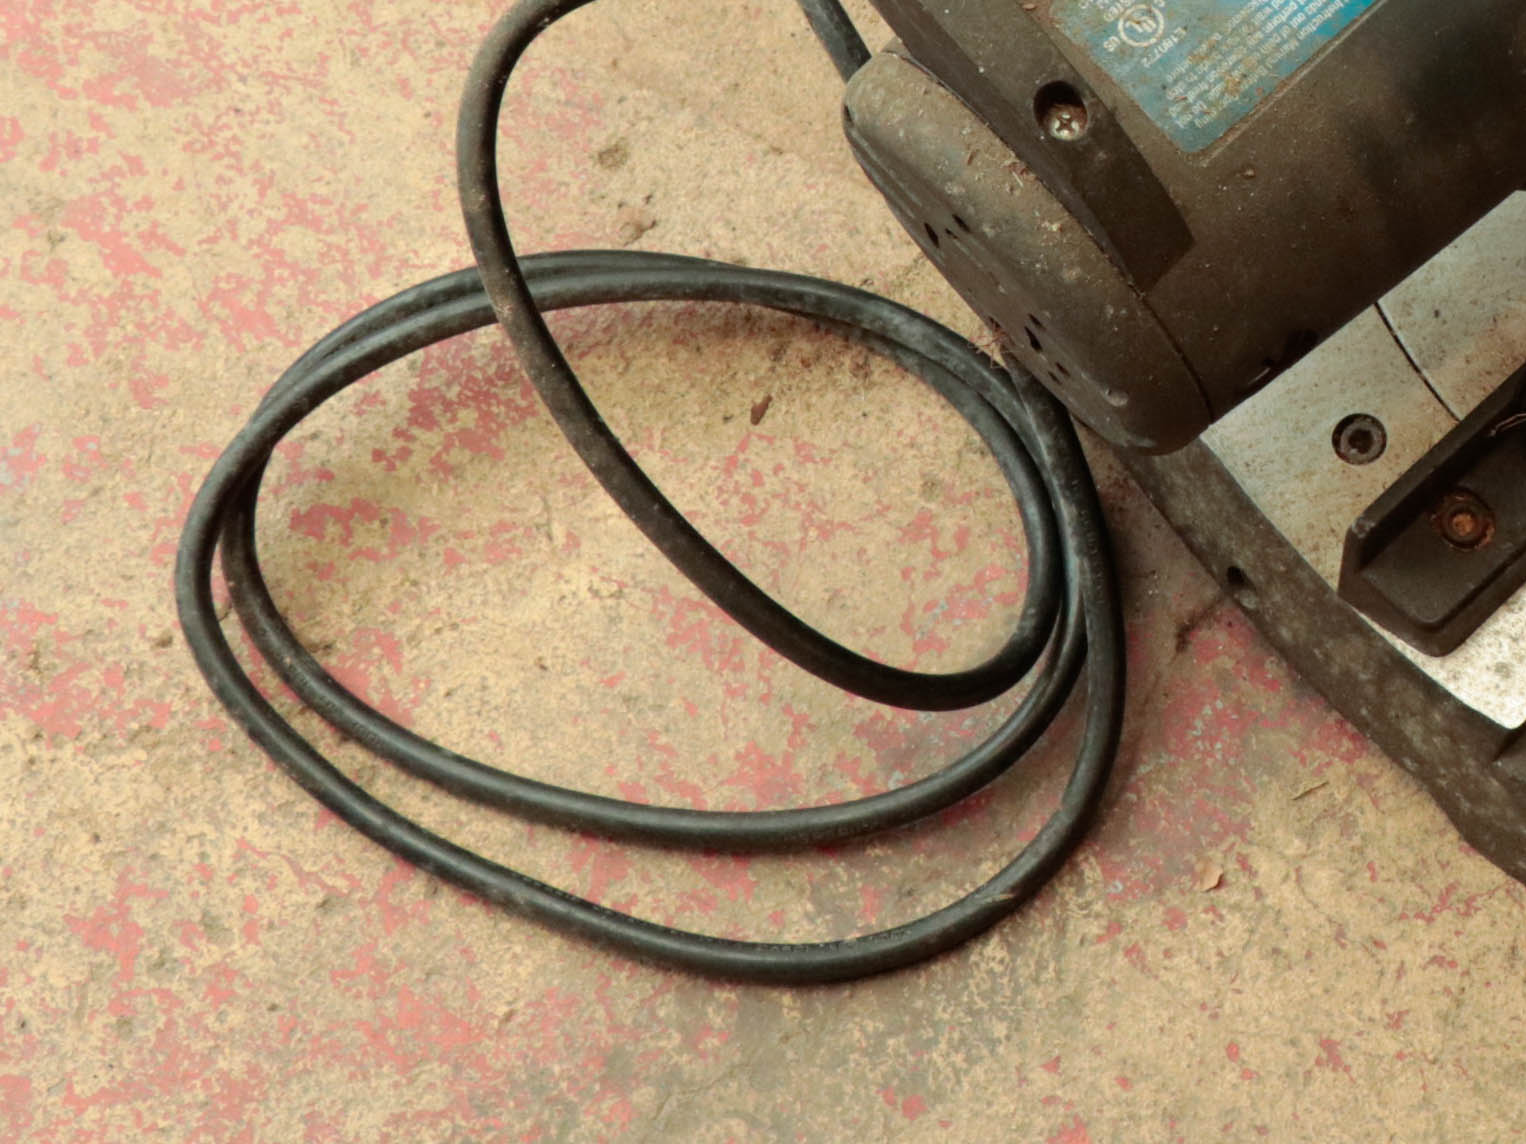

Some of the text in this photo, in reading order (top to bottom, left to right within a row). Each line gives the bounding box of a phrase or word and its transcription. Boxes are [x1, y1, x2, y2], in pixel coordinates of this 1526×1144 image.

[1259, 0, 1299, 34] perform
[1287, 10, 1307, 29] out
[1101, 33, 1121, 53] US
